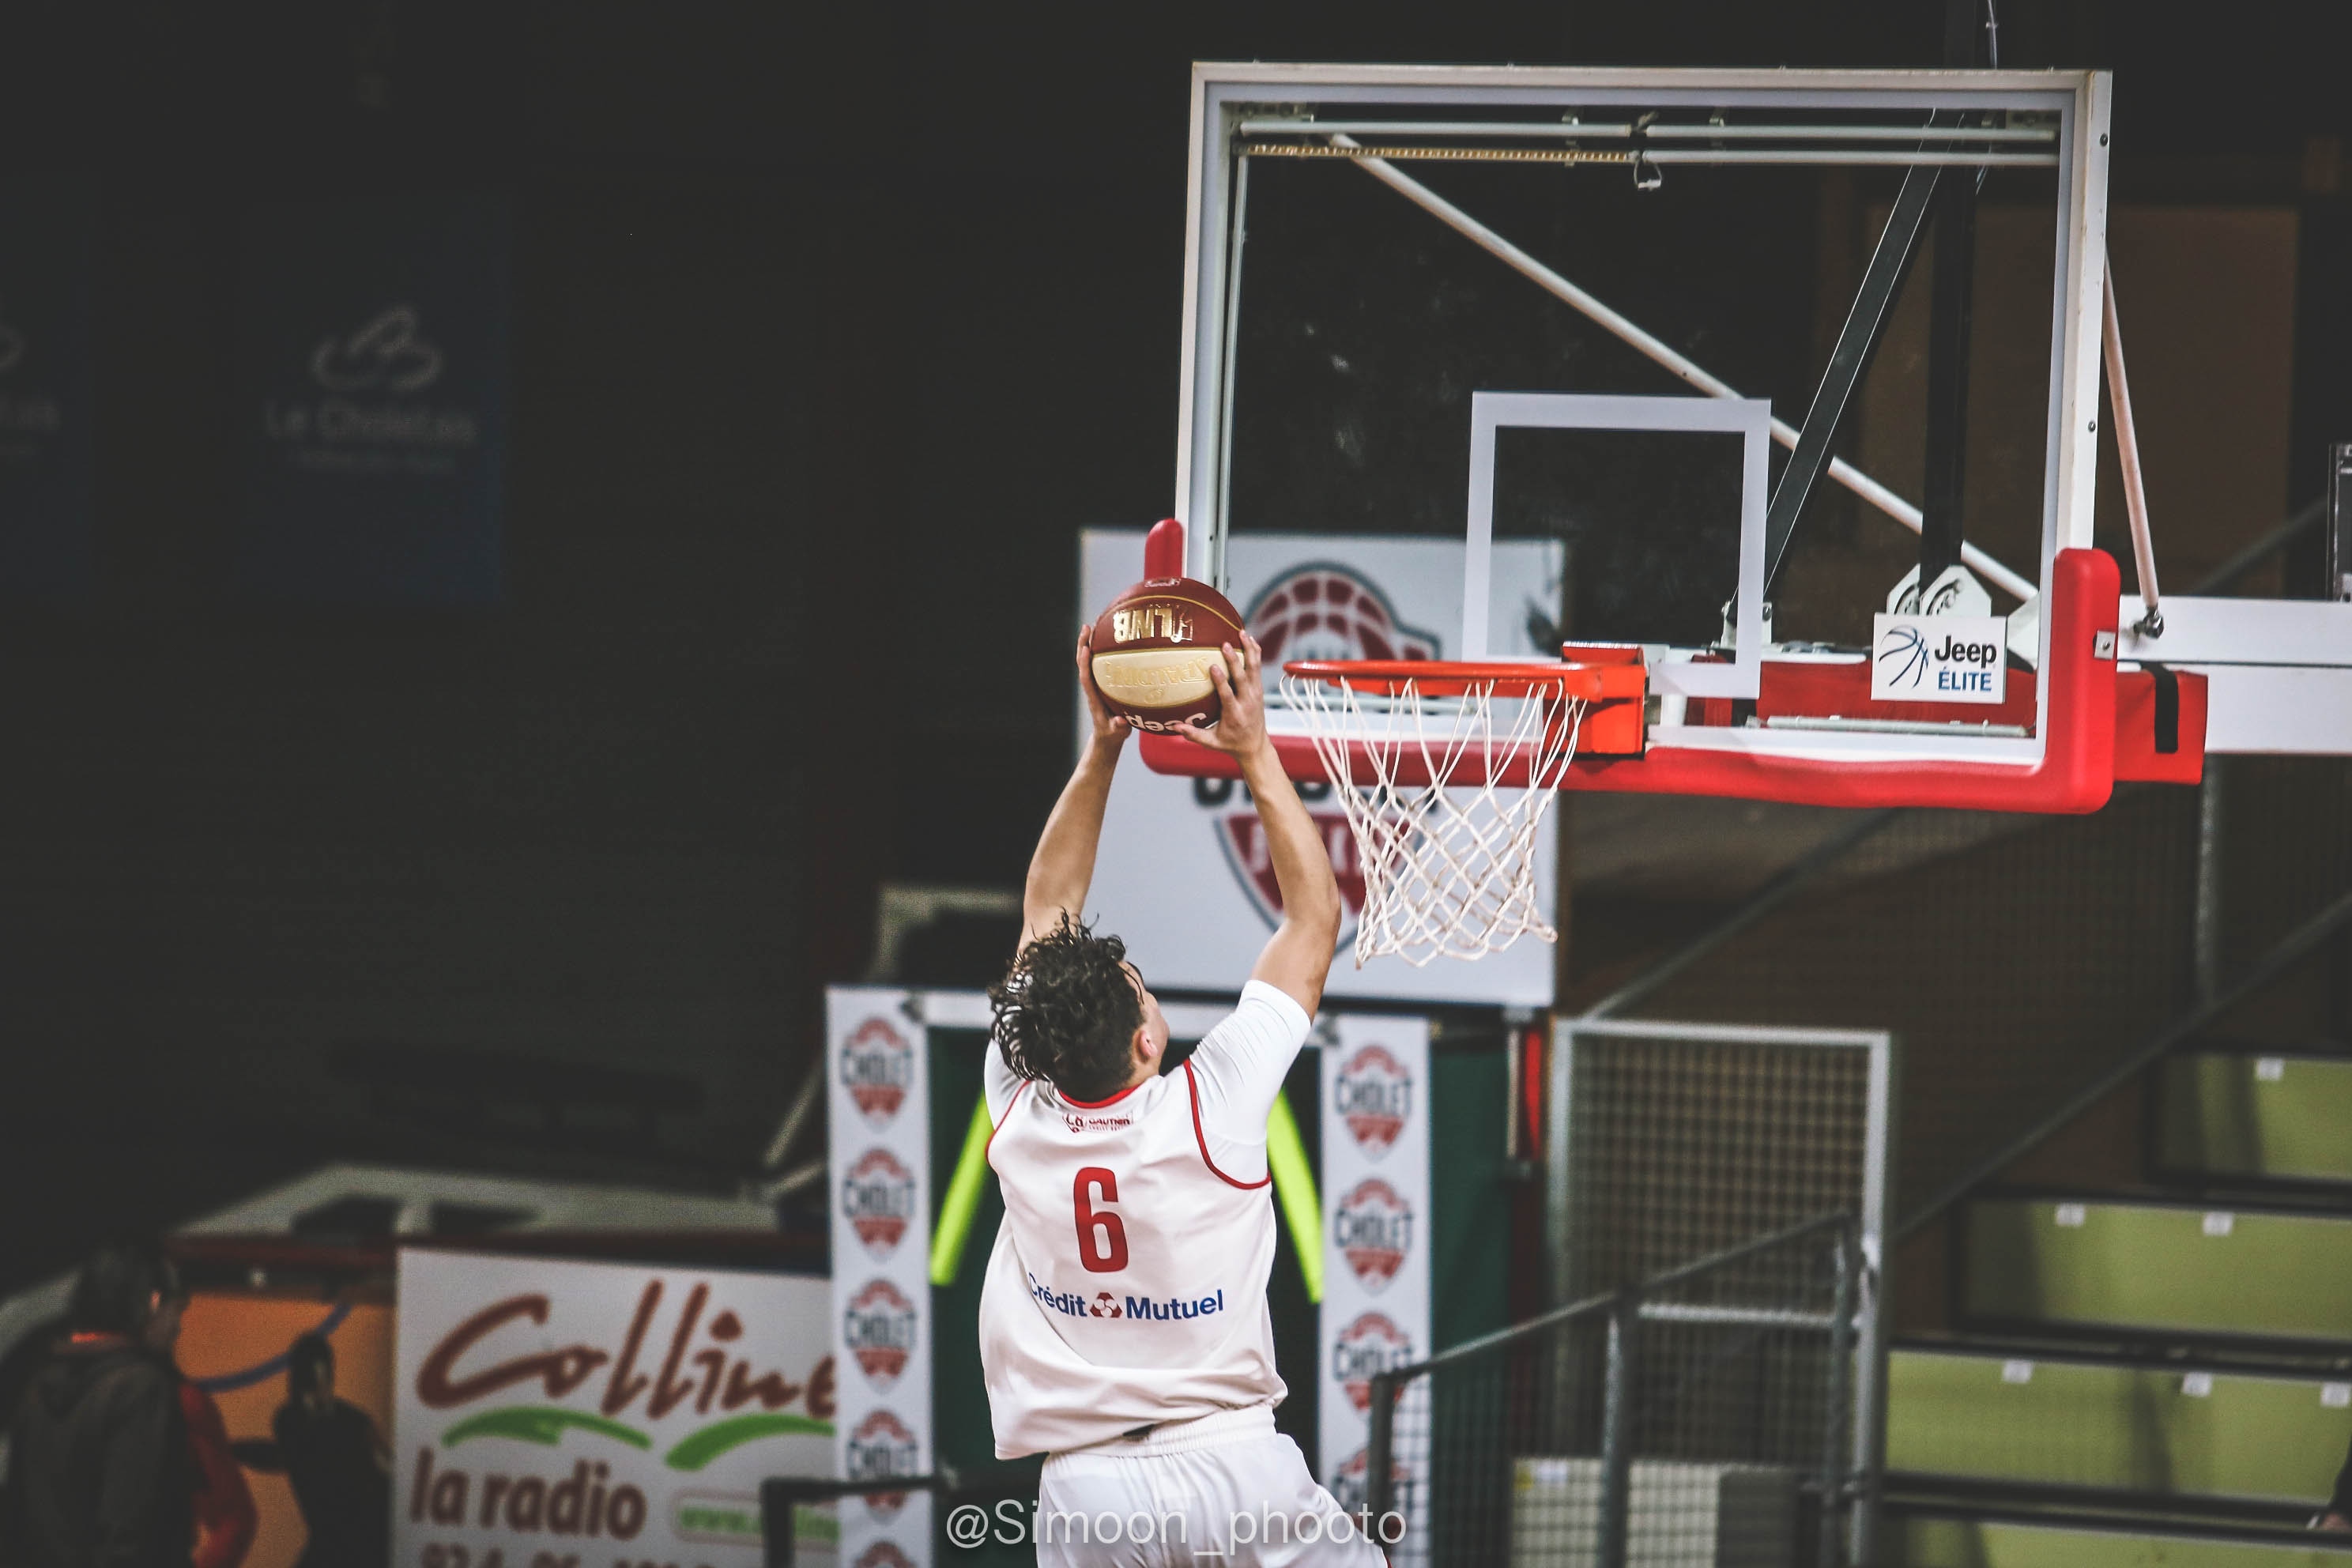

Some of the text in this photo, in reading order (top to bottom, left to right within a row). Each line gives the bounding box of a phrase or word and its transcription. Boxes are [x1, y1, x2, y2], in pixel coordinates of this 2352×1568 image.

[1113, 608, 1173, 644] LNB
[1935, 635, 1997, 669] Jeep
[1938, 666, 1992, 692] ÉLITE
[1073, 1167, 1129, 1272] 6
[1028, 1272, 1224, 1321] Crédit Mutuel
[410, 1447, 469, 1526] la
[477, 1459, 647, 1540] radio
